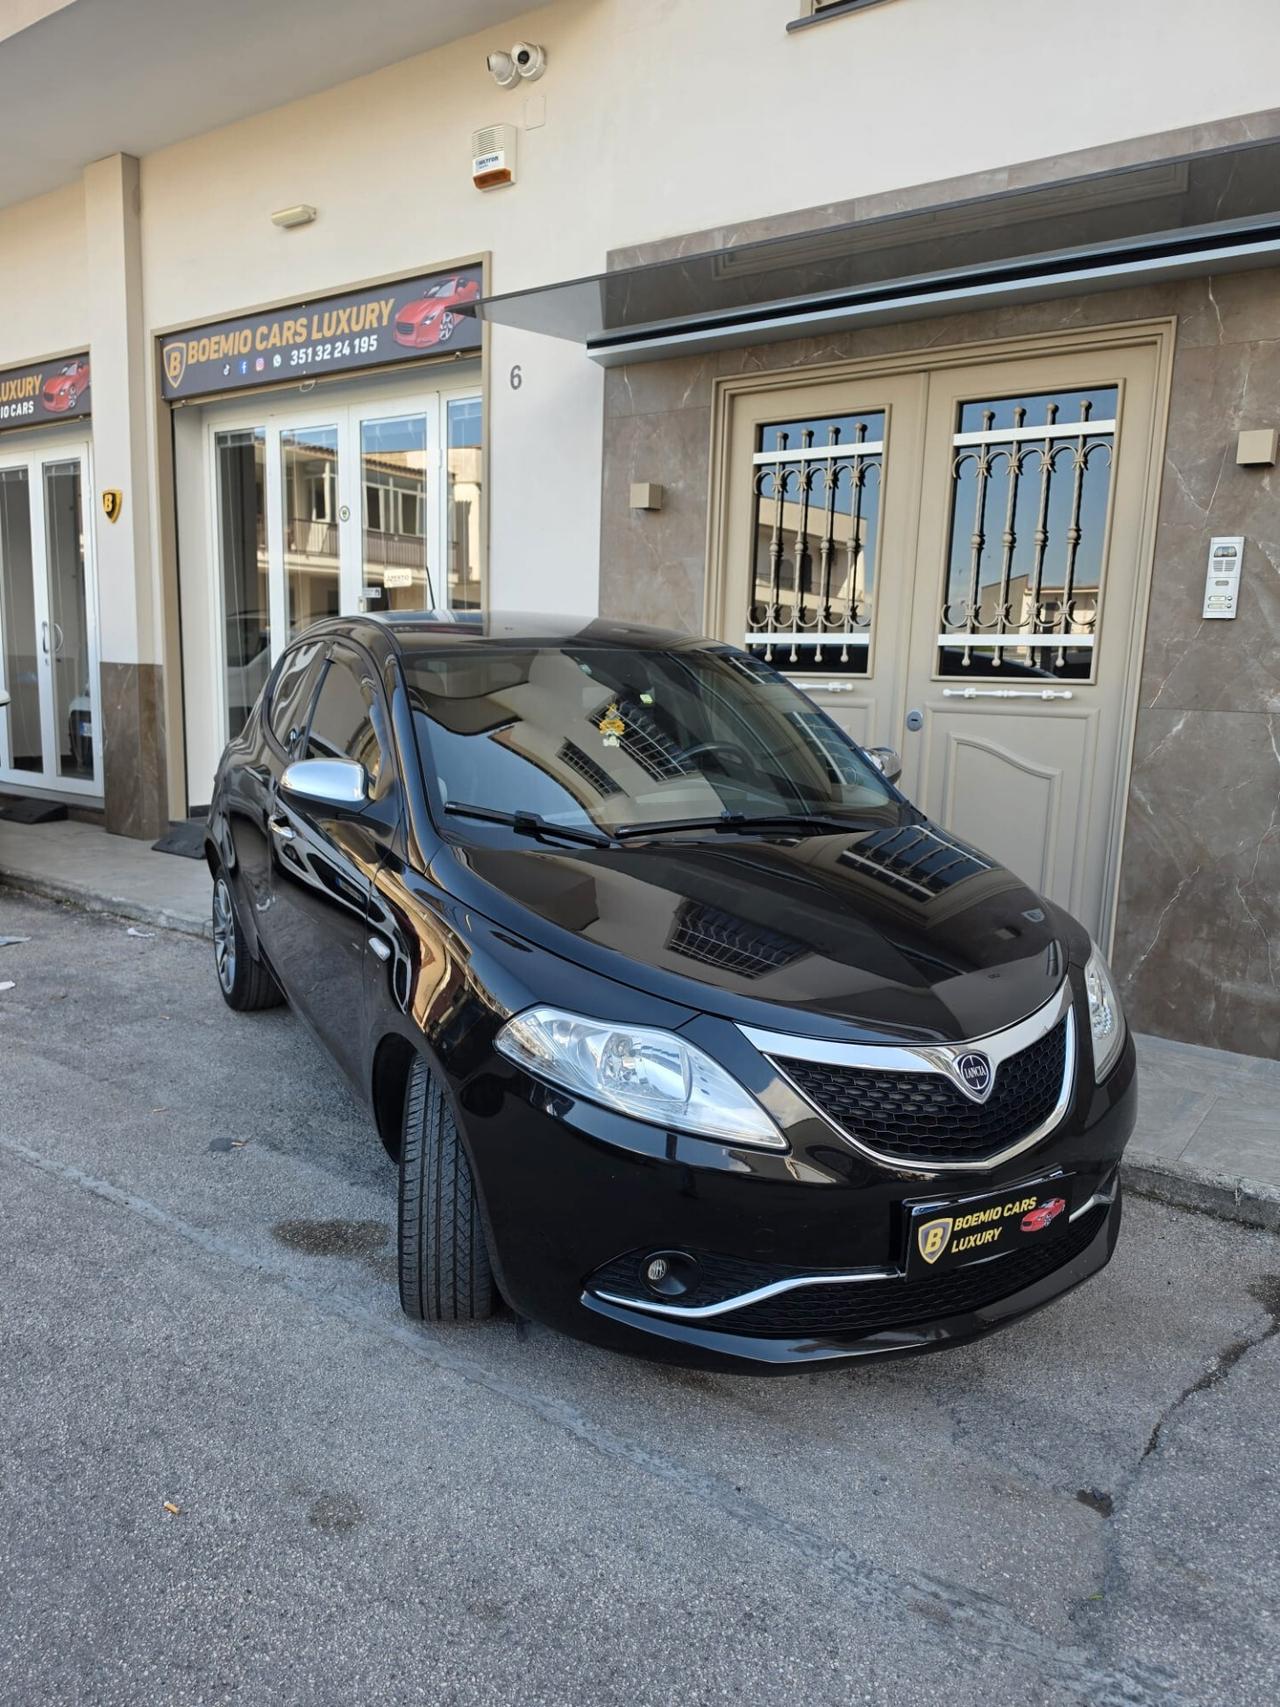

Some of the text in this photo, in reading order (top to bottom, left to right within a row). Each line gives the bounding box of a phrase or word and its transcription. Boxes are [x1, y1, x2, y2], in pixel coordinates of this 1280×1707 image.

[187, 298, 396, 365] BOEMIO CARS LUXURY
[290, 334, 378, 366] 351 32 24 195
[169, 351, 182, 377] B
[510, 364, 522, 390] 6
[0, 374, 42, 403] UXURY
[10, 400, 34, 417] CARS
[963, 1065, 987, 1079] LANCIA
[953, 1196, 1037, 1231] BOEMIO CARS
[924, 1227, 944, 1254] B
[951, 1226, 1003, 1254] LUXURY
